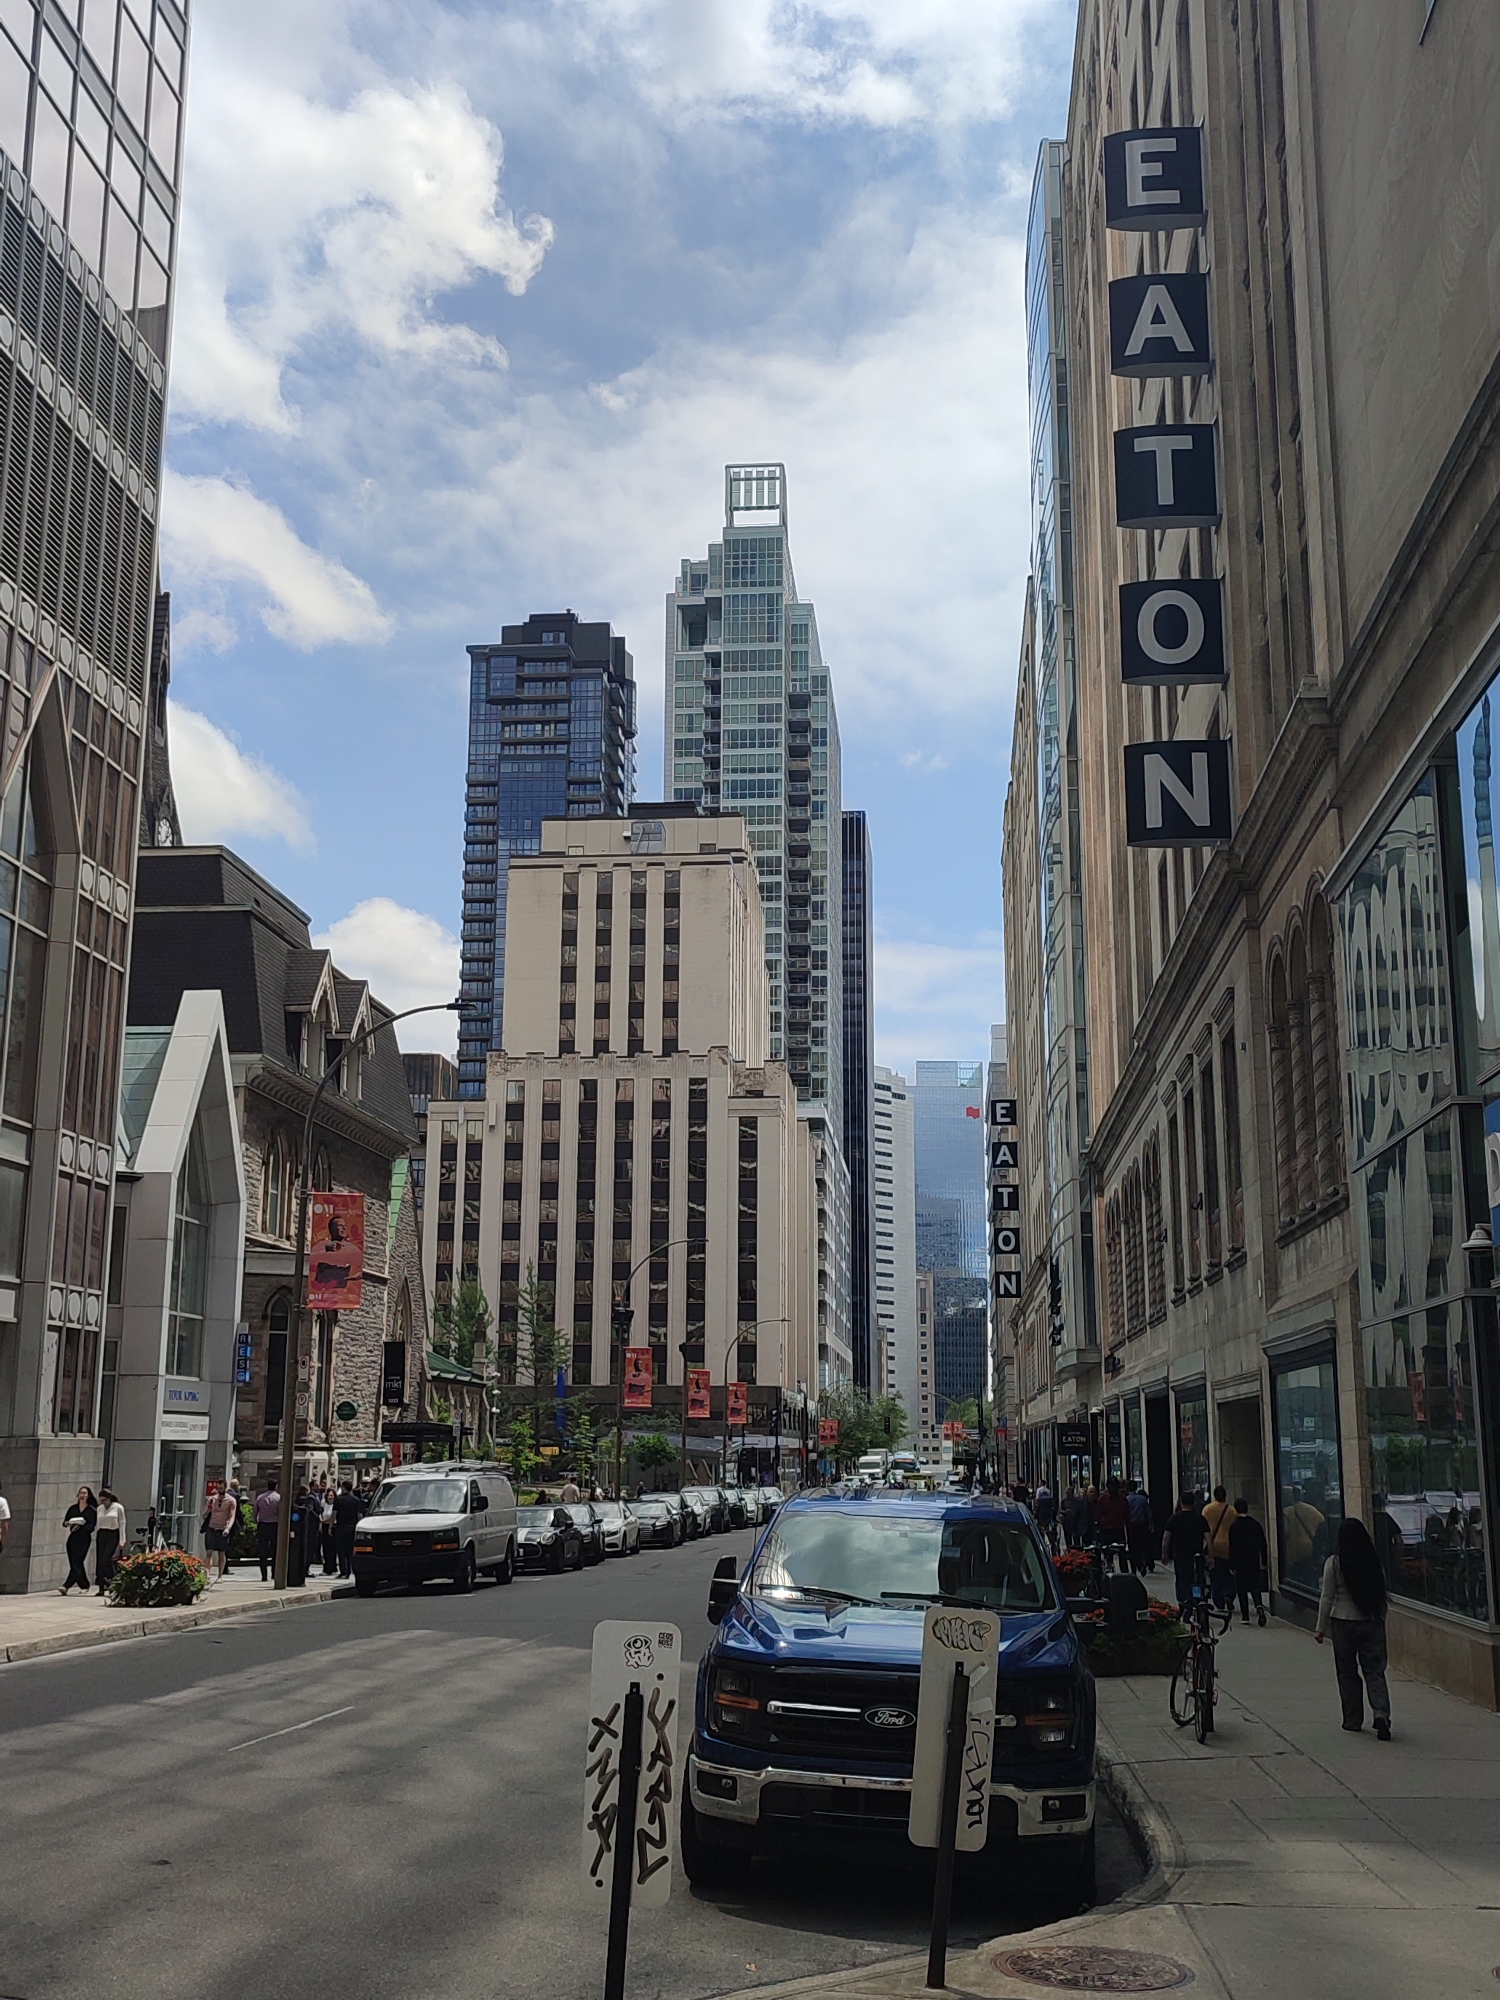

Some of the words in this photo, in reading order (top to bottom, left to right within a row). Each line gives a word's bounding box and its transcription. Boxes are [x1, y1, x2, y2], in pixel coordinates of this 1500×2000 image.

[1122, 136, 1211, 829] EATON
[994, 1101, 1017, 1296] EATON
[1062, 1435, 1087, 1443] EATON
[874, 1710, 907, 1725] Ford
